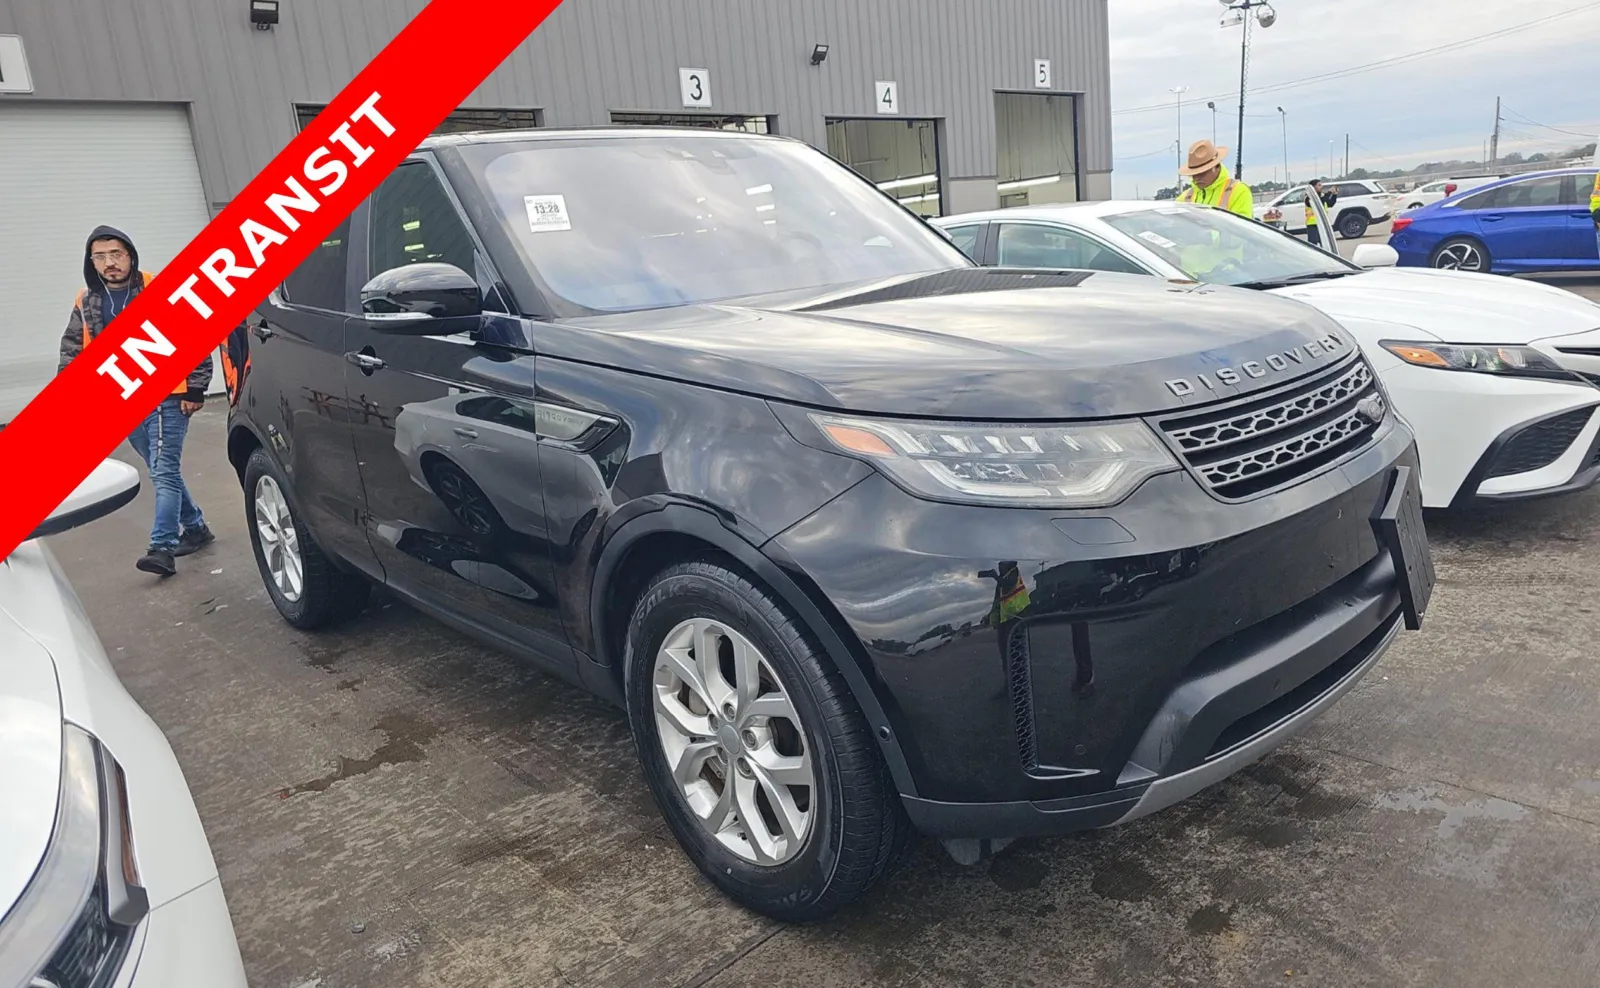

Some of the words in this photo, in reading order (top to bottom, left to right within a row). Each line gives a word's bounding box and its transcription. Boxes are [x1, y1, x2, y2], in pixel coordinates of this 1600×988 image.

[689, 74, 703, 101] 3
[1039, 64, 1047, 84] 5
[881, 86, 893, 109] 4
[1165, 332, 1343, 397] DISCOVERY
[636, 582, 717, 628] FALKE
